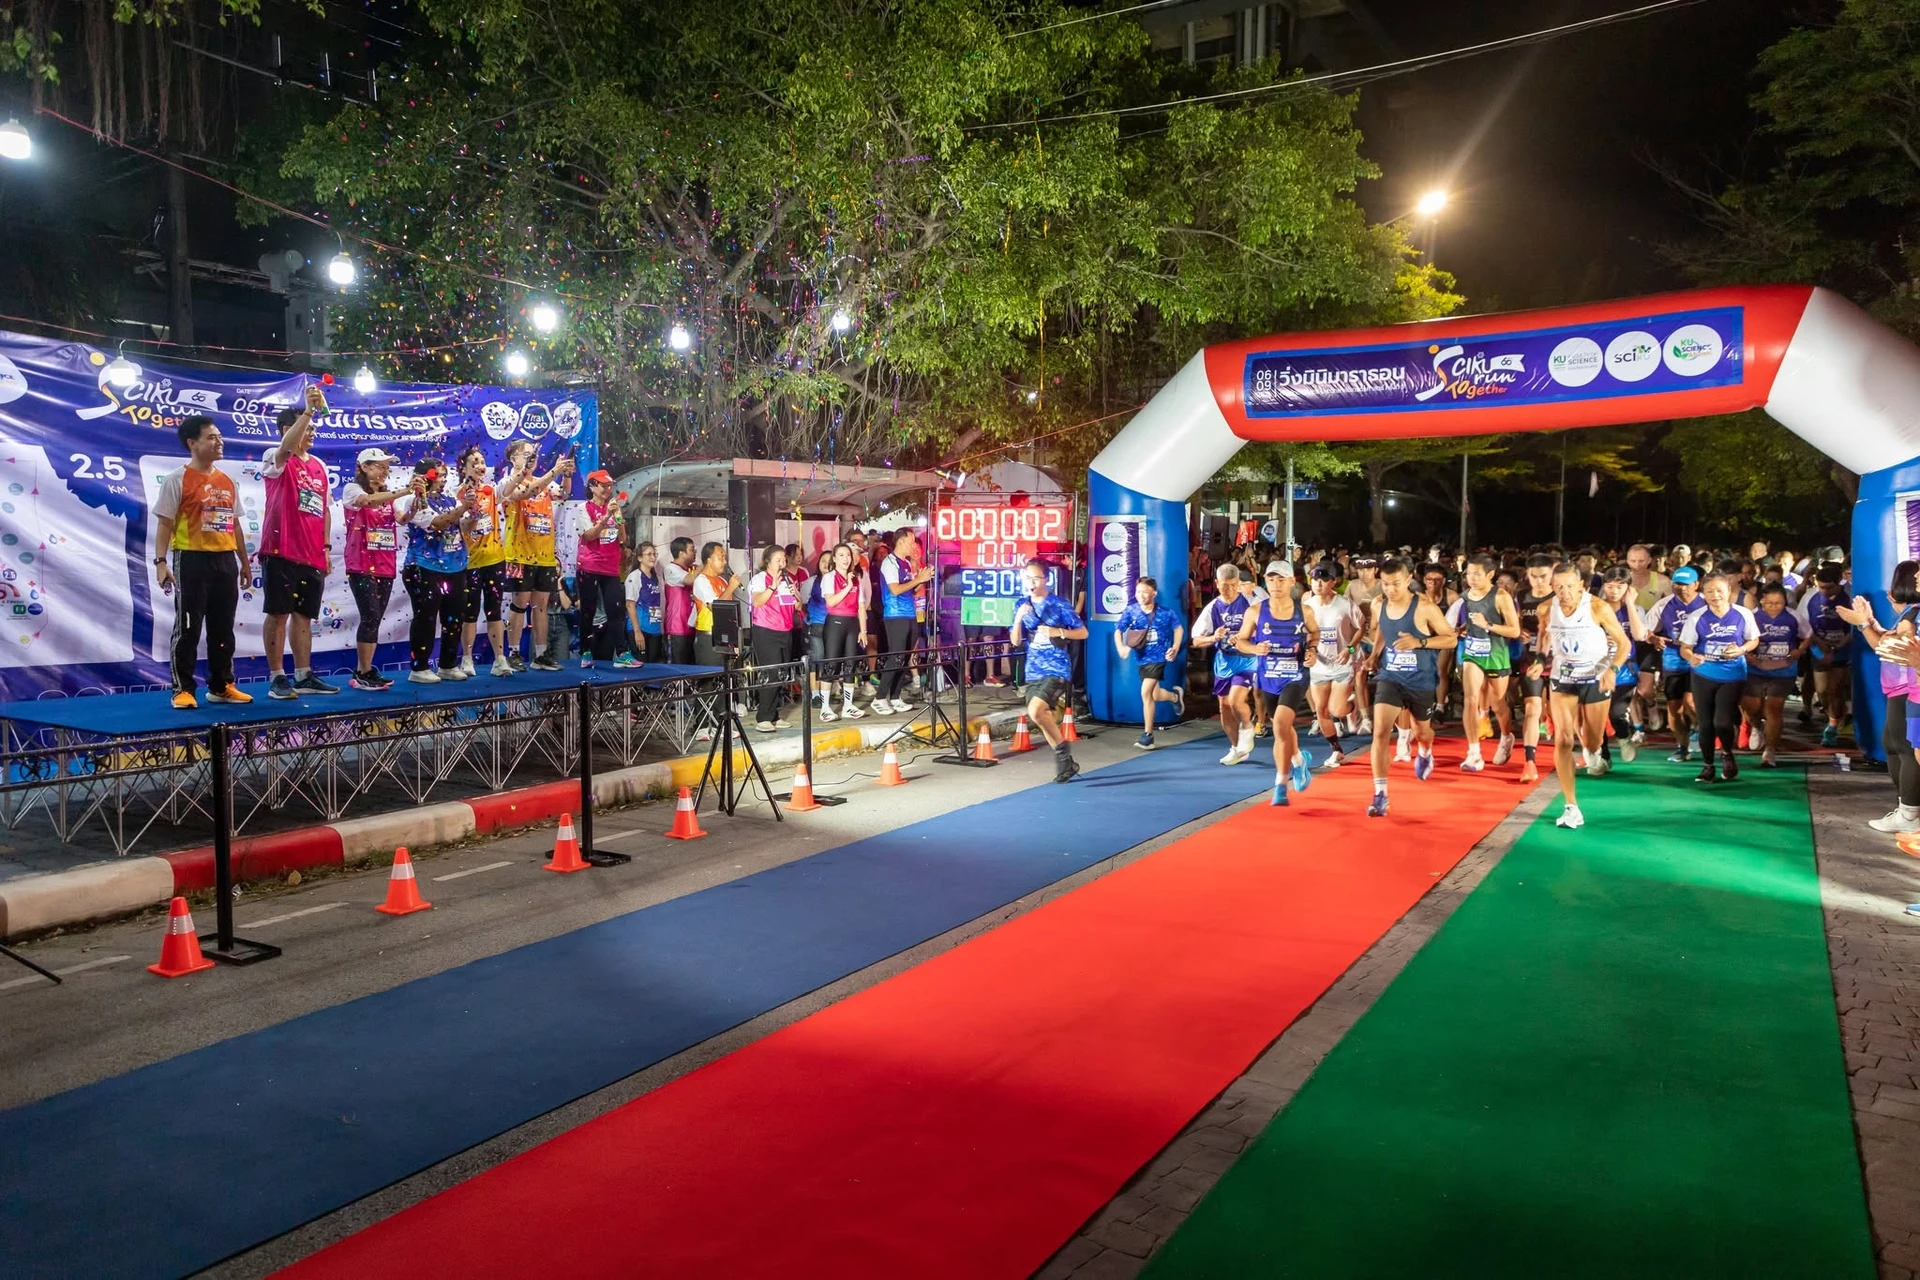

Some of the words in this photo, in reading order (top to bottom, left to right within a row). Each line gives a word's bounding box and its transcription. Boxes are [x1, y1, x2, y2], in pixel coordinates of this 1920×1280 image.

[1553, 355, 1566, 364] KU
[1568, 356, 1598, 365] SCIENCE
[1256, 370, 1271, 380] 06
[1279, 366, 1405, 387] วิ่งมินิมาราธอน
[1474, 372, 1516, 385] run
[1256, 381, 1271, 391] 09
[232, 397, 259, 413] 06
[119, 403, 185, 429] TOget
[231, 412, 258, 426] 09
[237, 426, 263, 435] 2026
[70, 454, 127, 481] 2.5
[108, 484, 128, 494] KM
[938, 508, 1061, 541] 00:00:02
